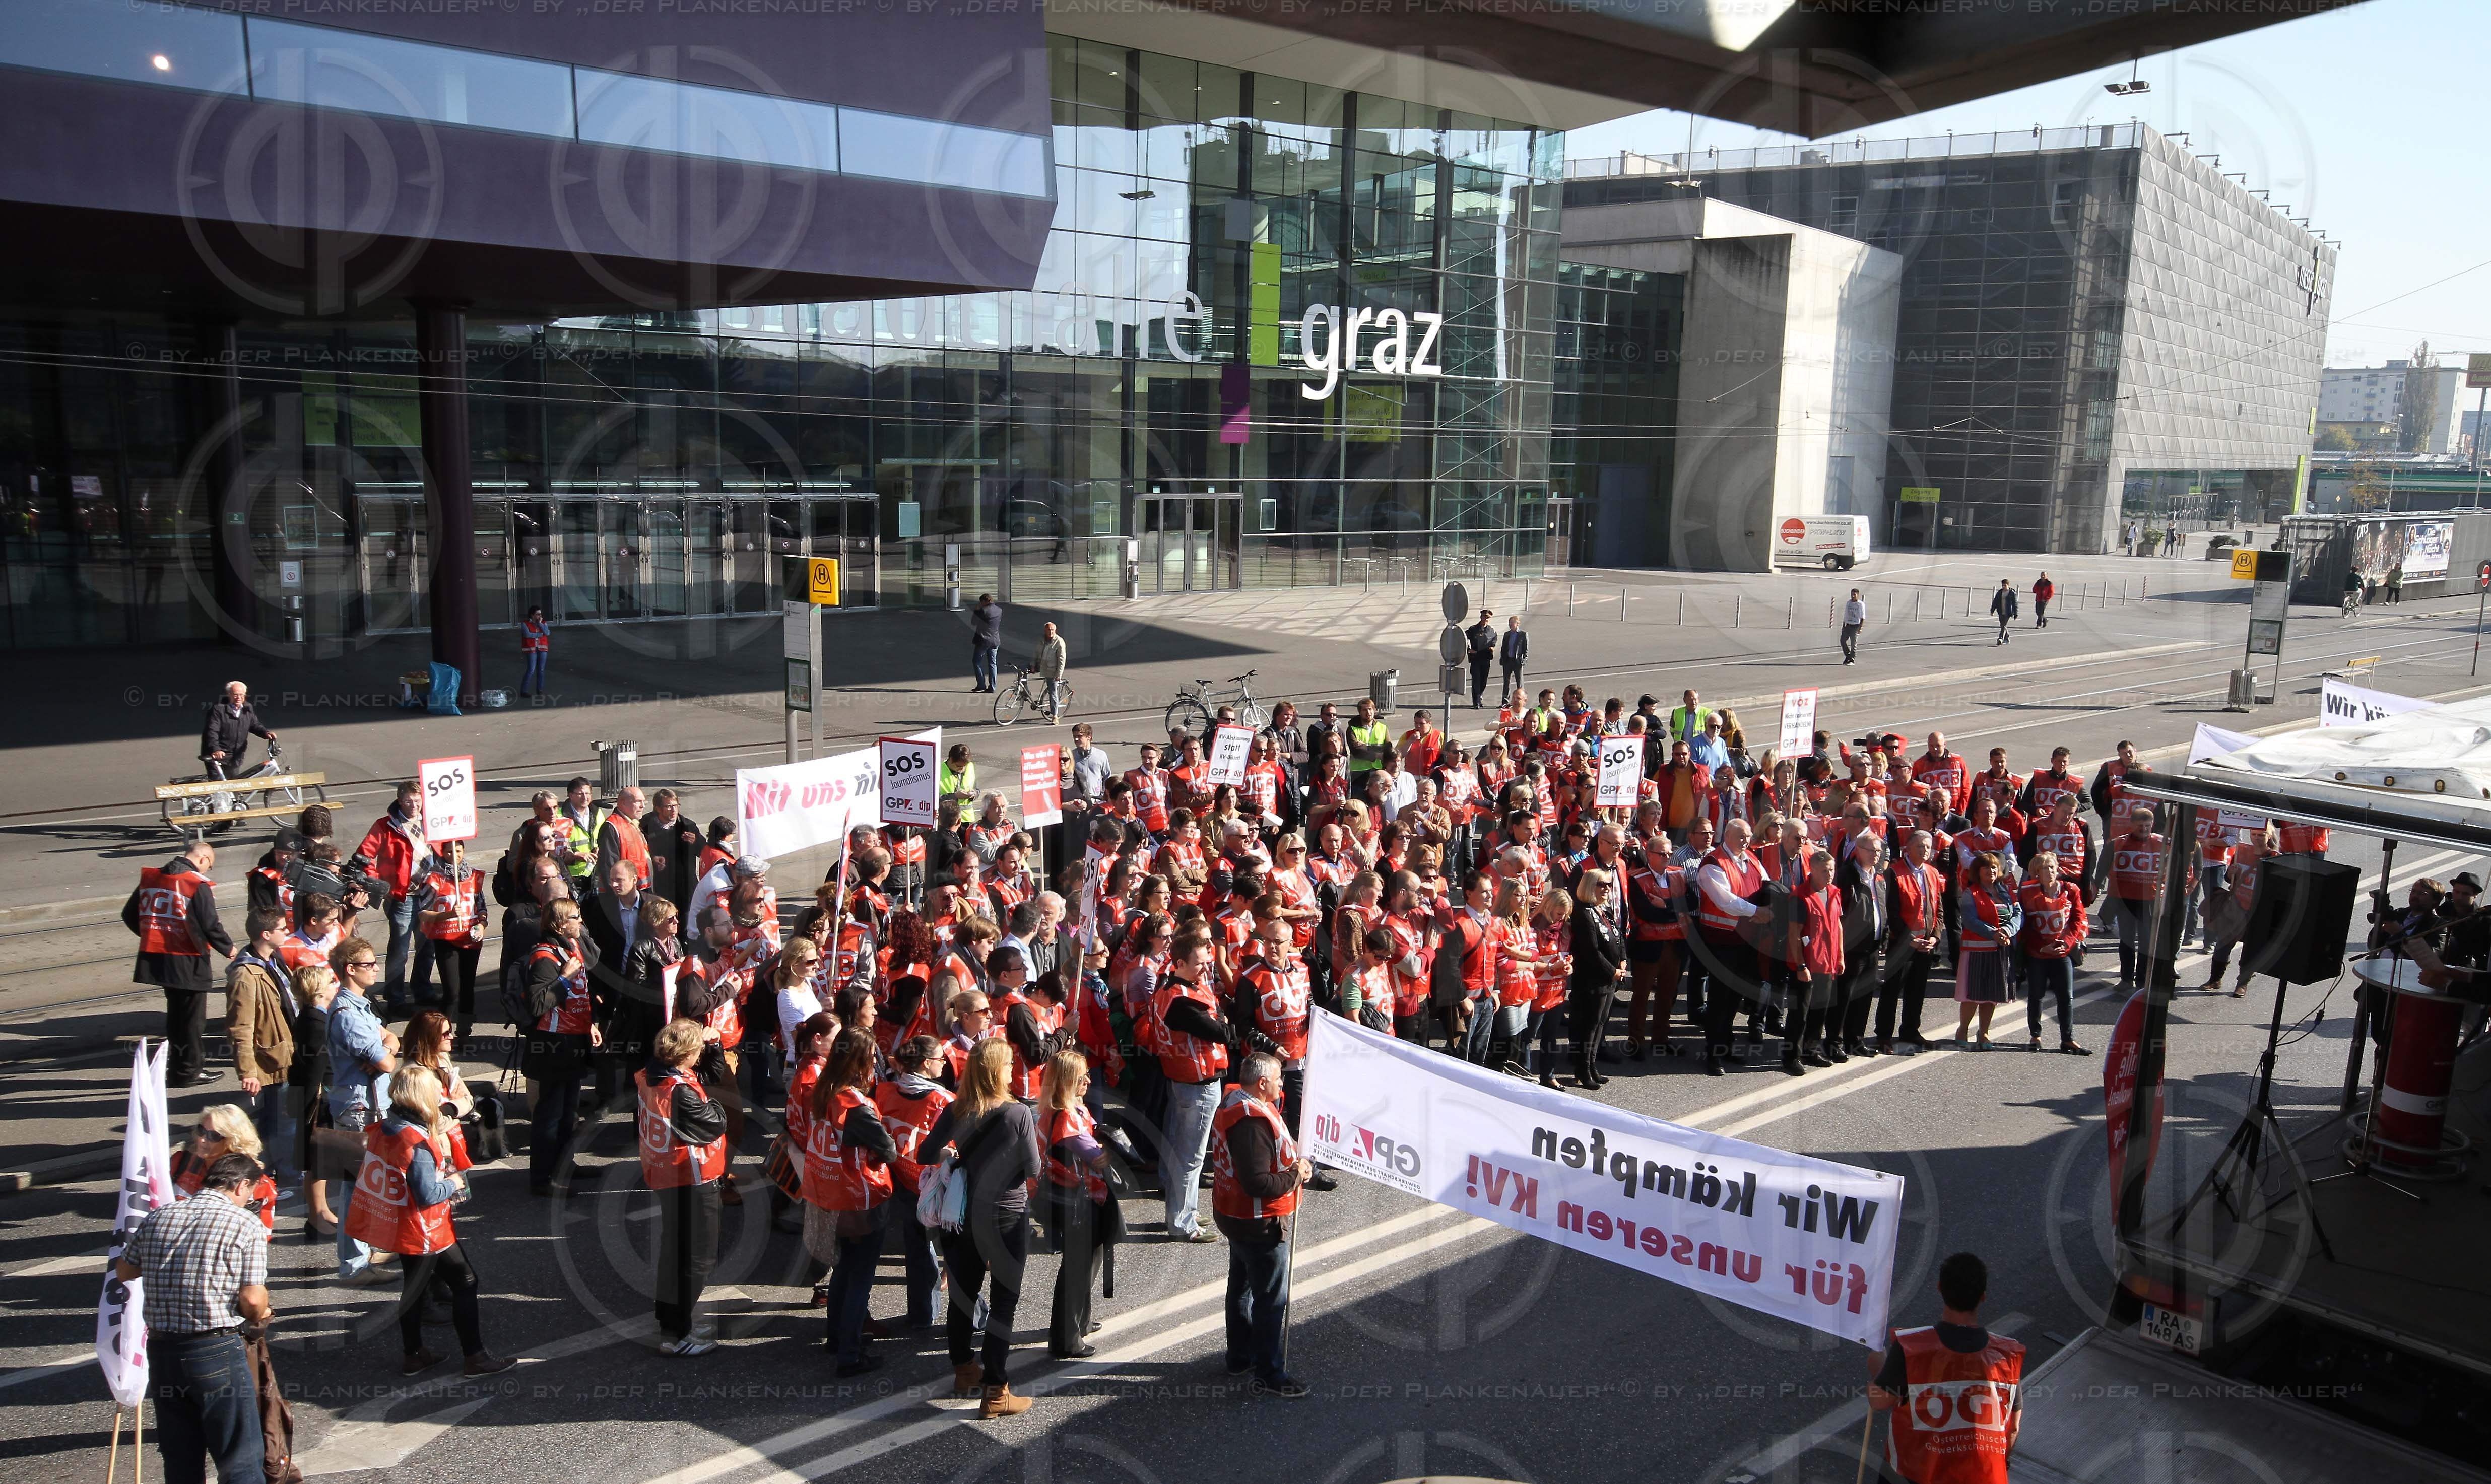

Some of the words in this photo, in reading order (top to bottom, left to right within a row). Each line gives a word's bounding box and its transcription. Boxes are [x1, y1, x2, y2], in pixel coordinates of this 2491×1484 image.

[1301, 303, 1441, 400] graz
[2356, 523, 2369, 541] CATS
[2327, 693, 2357, 718] Wir
[2362, 701, 2390, 721] kä
[885, 752, 925, 776] SOS
[1604, 745, 1635, 768] SOS
[890, 771, 931, 790] Journalismus
[1606, 761, 1638, 779] Journalismus
[427, 768, 464, 797] SOS
[1627, 786, 1635, 794] djp
[745, 779, 792, 819] Mit
[801, 779, 847, 808] uns
[919, 800, 931, 812] djp
[463, 815, 472, 824] djp
[1084, 858, 1095, 883] OS
[2161, 1310, 2179, 1330] RA
[2147, 1322, 2171, 1342] 148
[2174, 1334, 2194, 1351] AS
